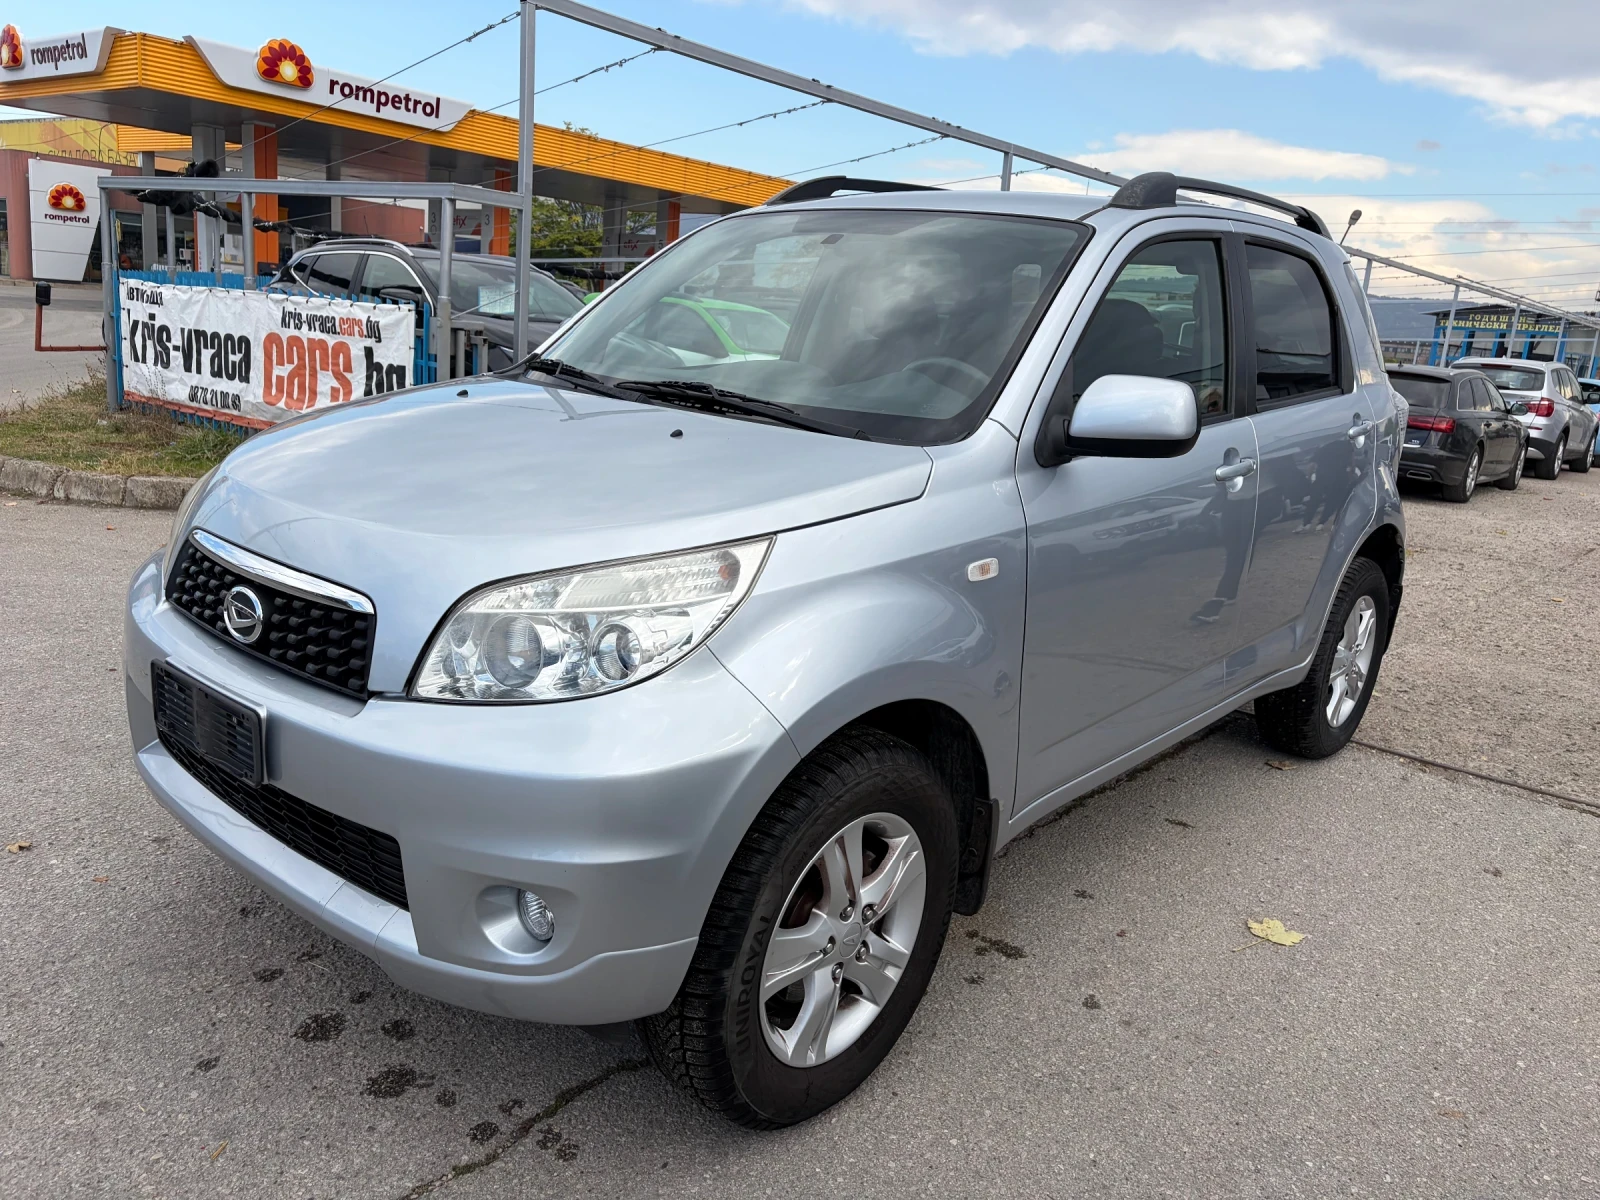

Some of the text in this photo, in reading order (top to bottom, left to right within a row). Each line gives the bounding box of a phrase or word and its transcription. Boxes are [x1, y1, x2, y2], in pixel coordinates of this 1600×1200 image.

[30, 32, 88, 70] rompetrol
[328, 78, 441, 120] rompetrol
[44, 212, 90, 224] rompetrol
[484, 214, 490, 226] 3
[280, 306, 382, 344] kris-vraca.cars.bg
[127, 309, 251, 384] kris-vraca
[262, 331, 353, 411] cars
[188, 385, 209, 405] 0878
[210, 388, 219, 408] 21
[220, 390, 231, 409] 00
[735, 907, 777, 1056] UNIROYAL
